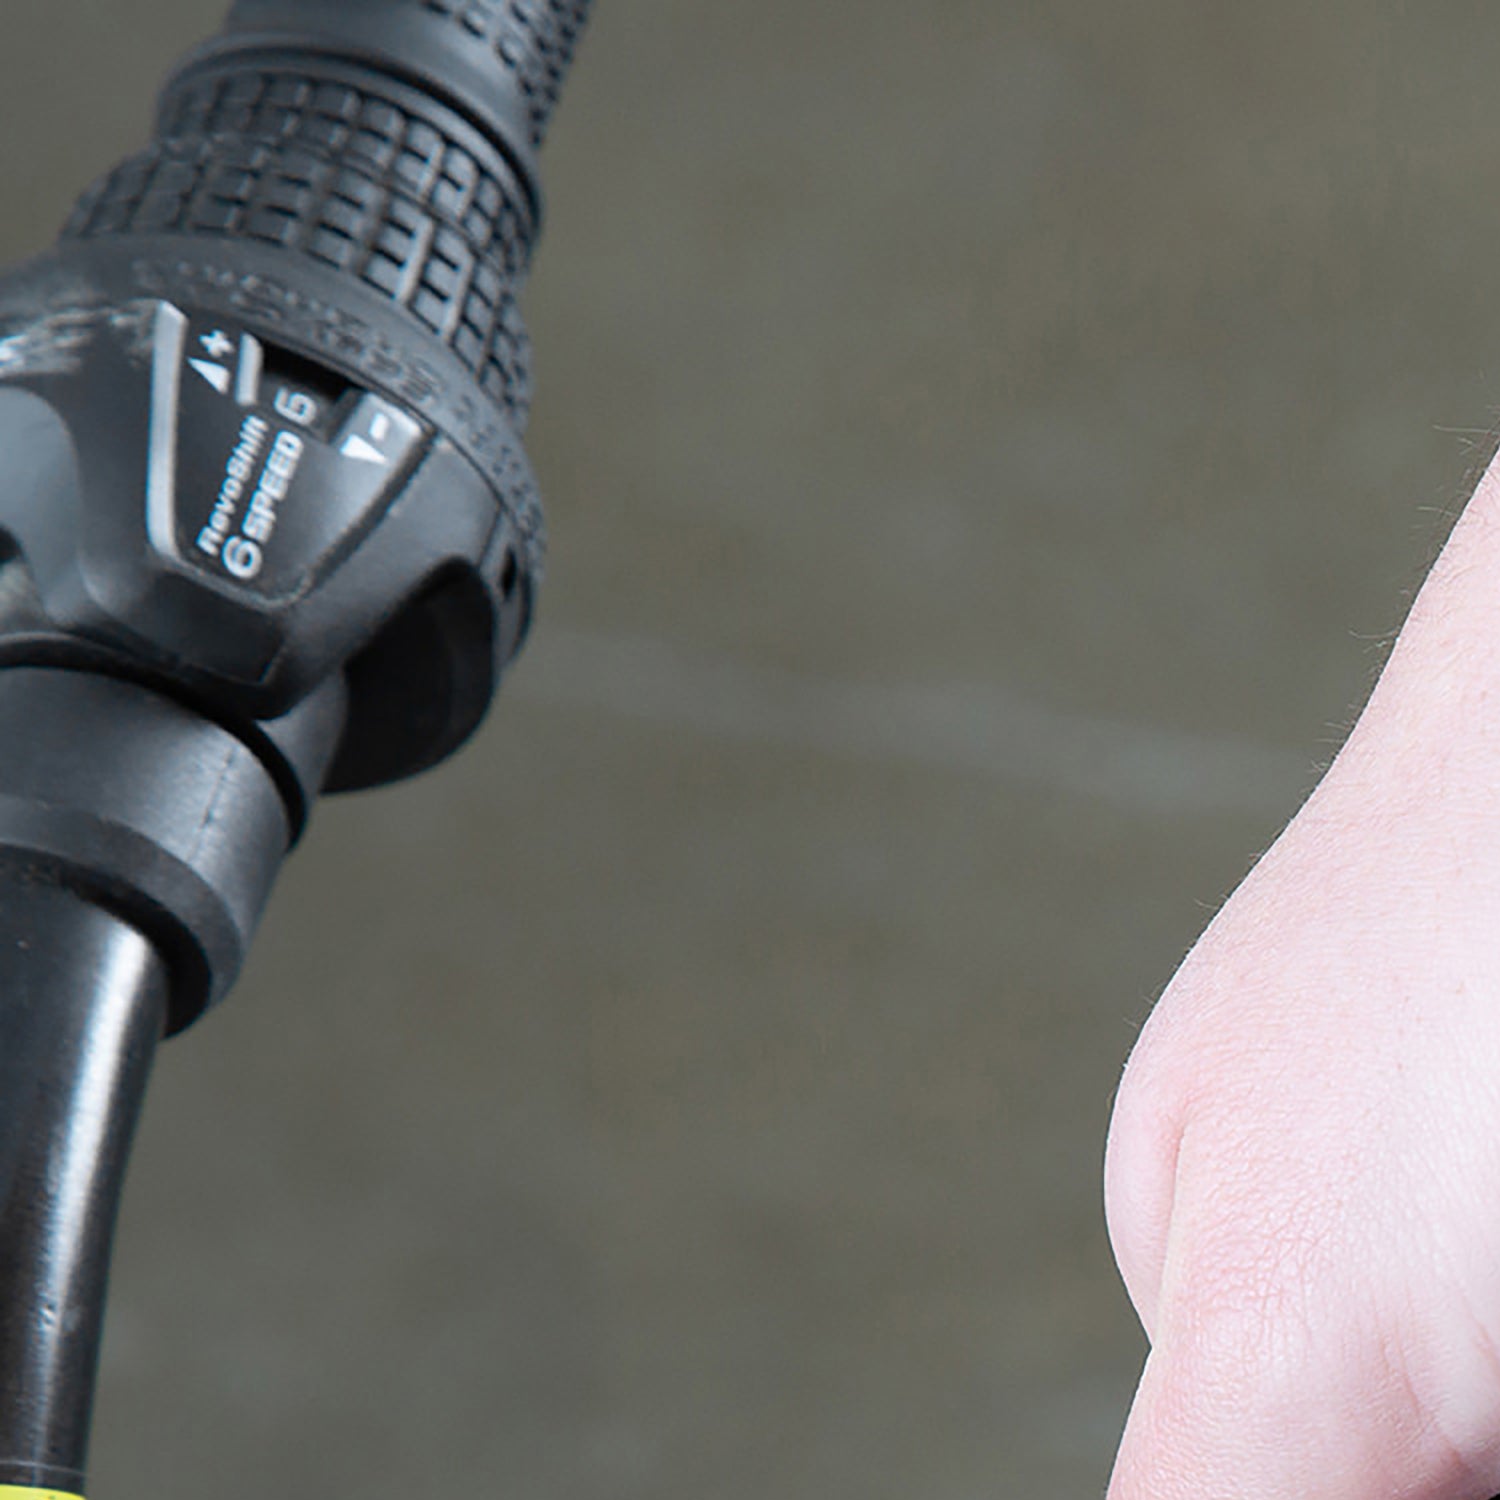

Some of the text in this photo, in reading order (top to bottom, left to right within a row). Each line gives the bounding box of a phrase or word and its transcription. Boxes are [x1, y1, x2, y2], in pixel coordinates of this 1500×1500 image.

[195, 414, 269, 556] RevoShift
[222, 429, 304, 579] 6 SPEED
